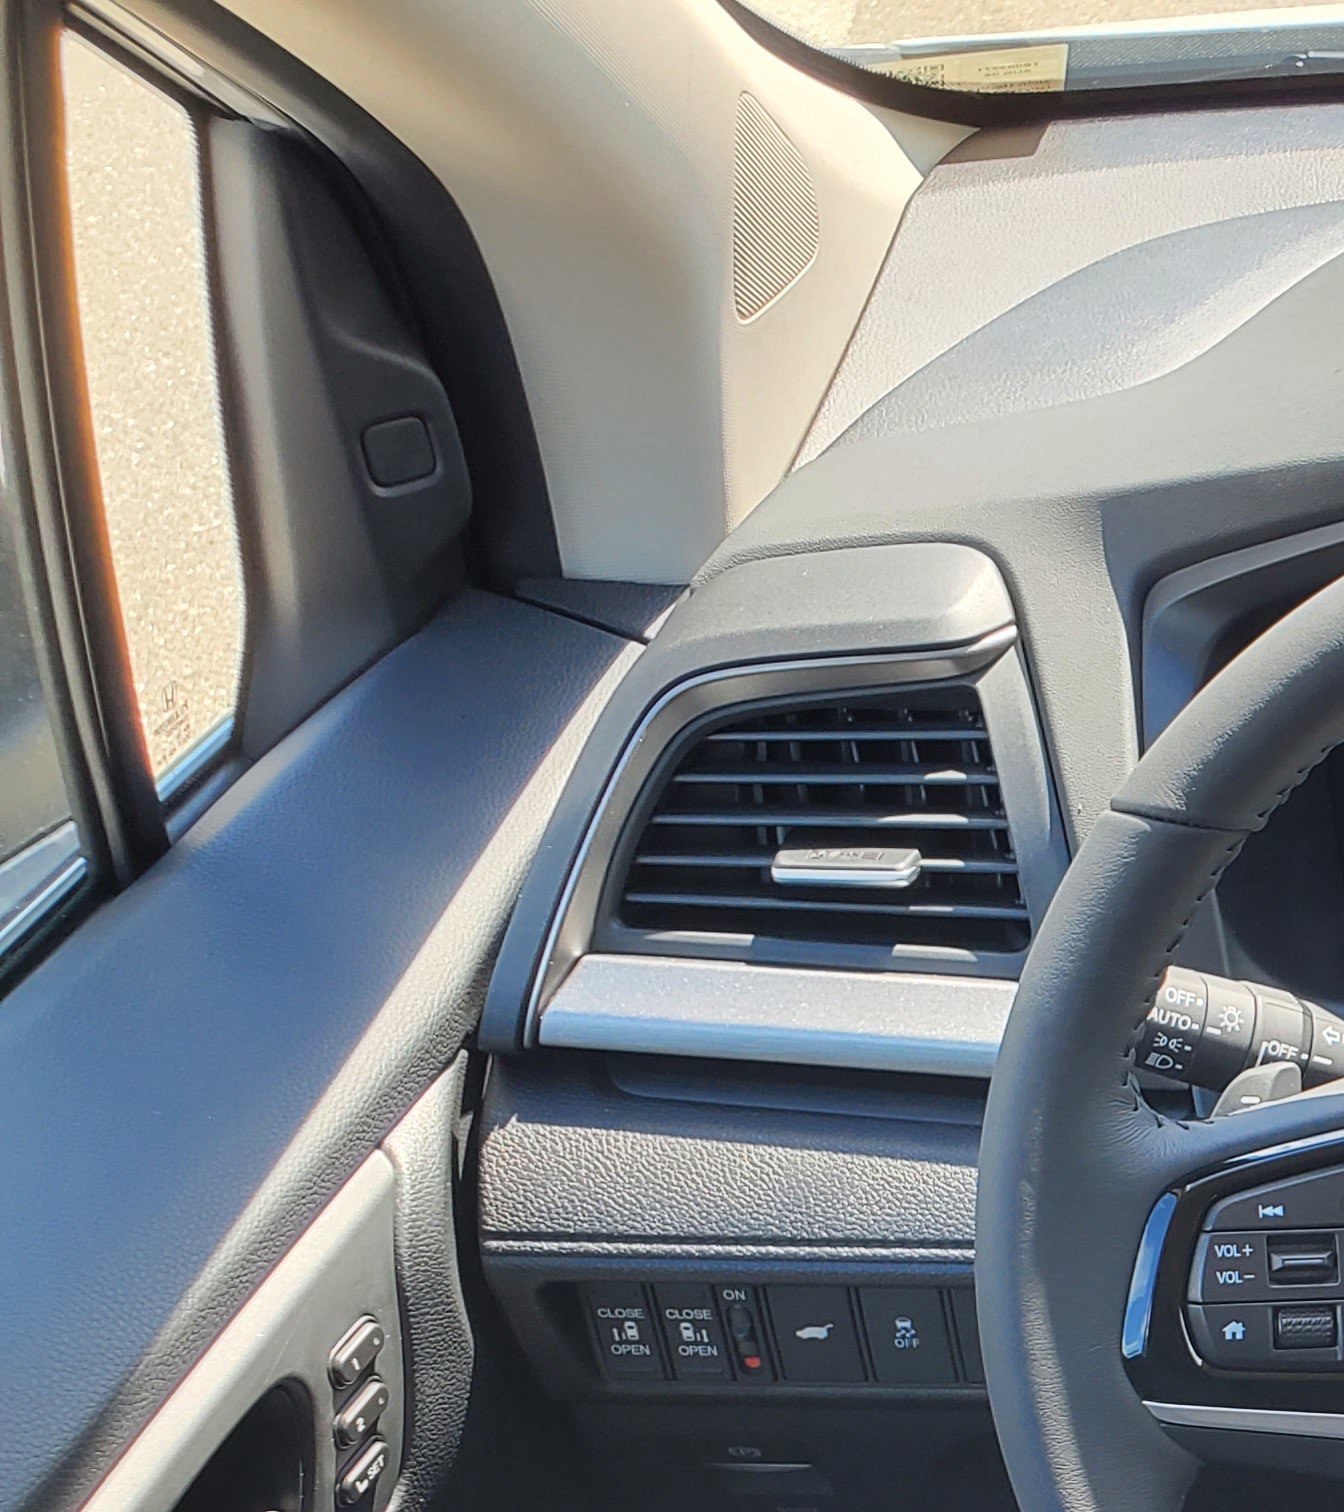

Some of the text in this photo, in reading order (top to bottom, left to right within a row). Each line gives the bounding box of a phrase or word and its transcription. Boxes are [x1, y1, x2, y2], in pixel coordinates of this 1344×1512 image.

[1165, 987, 1197, 1007] OFF
[1147, 1007, 1192, 1030] AUTO
[1268, 1041, 1299, 1060] OFF
[723, 1289, 746, 1301] ON
[597, 1307, 645, 1319] CLOSE
[665, 1308, 713, 1320] CLOSE
[894, 1337, 920, 1349] OFF
[610, 1344, 651, 1356] OPEN
[678, 1345, 718, 1357] OPEN
[367, 1454, 385, 1480] SET
